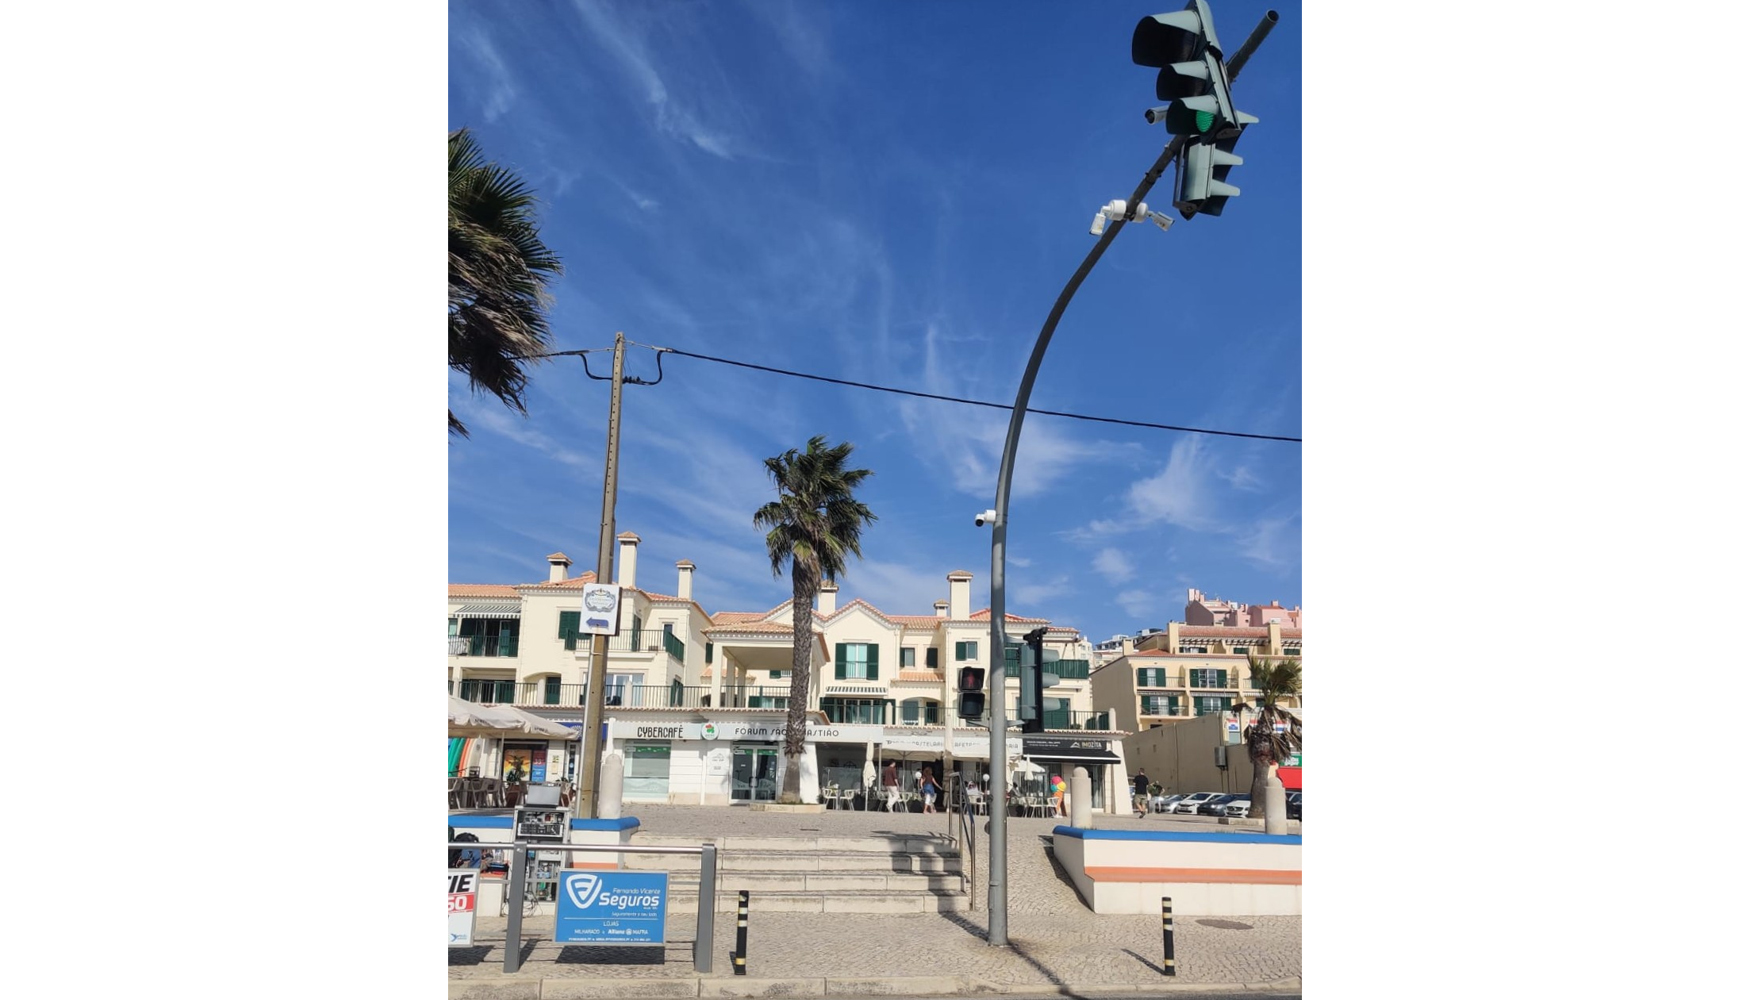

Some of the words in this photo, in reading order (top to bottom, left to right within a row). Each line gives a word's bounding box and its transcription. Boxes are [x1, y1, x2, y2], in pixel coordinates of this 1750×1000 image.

[637, 724, 684, 739] CYBERCAFÉ
[448, 873, 474, 894] IE
[612, 887, 639, 895] Fernando
[598, 892, 660, 910] Seguros
